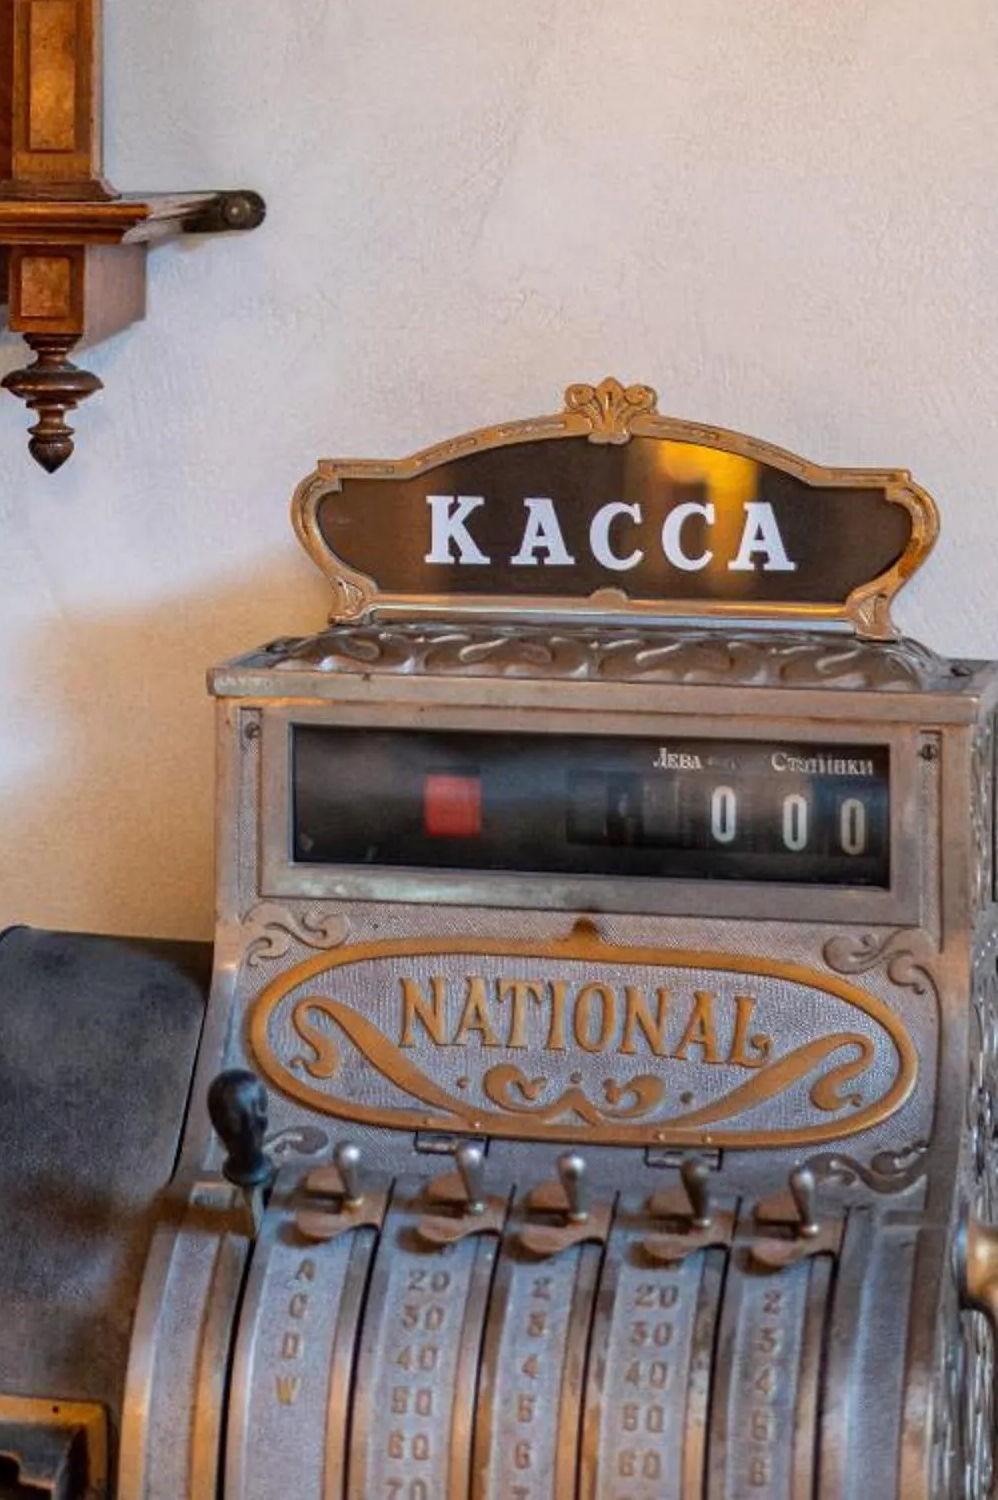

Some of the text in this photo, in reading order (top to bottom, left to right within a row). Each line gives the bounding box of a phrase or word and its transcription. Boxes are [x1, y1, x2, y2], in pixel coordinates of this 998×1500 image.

[424, 494, 796, 573] КАССА
[398, 975, 775, 1068] NATIONAL
[408, 1269, 450, 1293] 20
[635, 1283, 679, 1309] 20
[402, 1303, 445, 1330] 30
[630, 1320, 673, 1347] 30
[396, 1343, 438, 1371] 40
[624, 1357, 667, 1390] 40
[387, 1428, 430, 1461] 60
[515, 1439, 531, 1469] 6
[618, 1448, 661, 1481] 60
